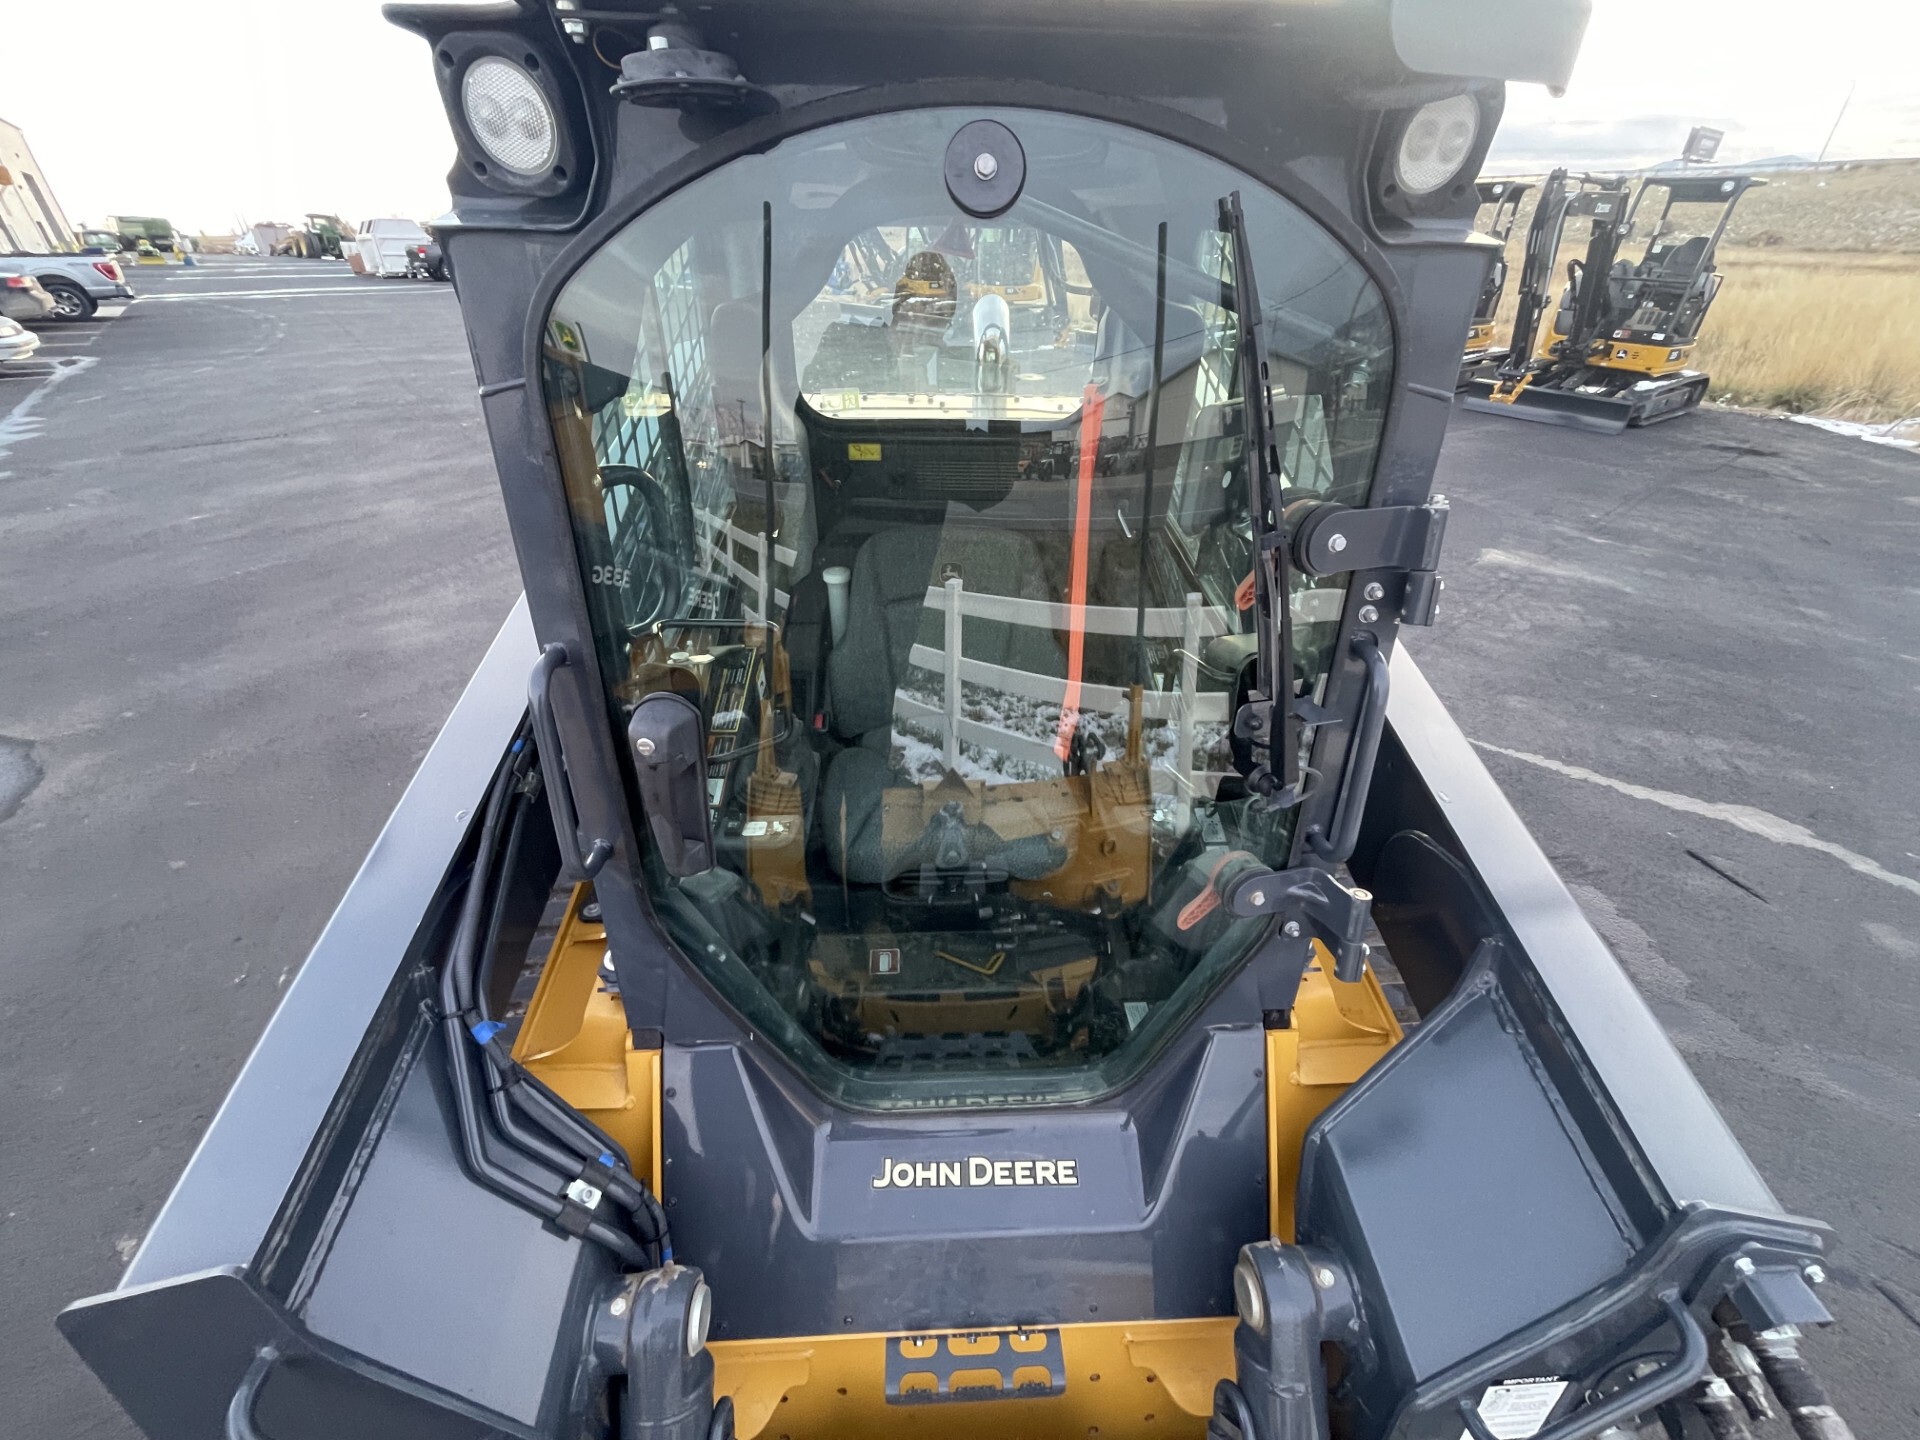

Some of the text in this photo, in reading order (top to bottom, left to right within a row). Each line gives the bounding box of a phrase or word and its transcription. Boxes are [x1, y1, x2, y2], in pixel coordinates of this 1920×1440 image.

[872, 1157, 1078, 1187] JOHN DEERE
[1503, 1376, 1560, 1385] IMPORTANT
